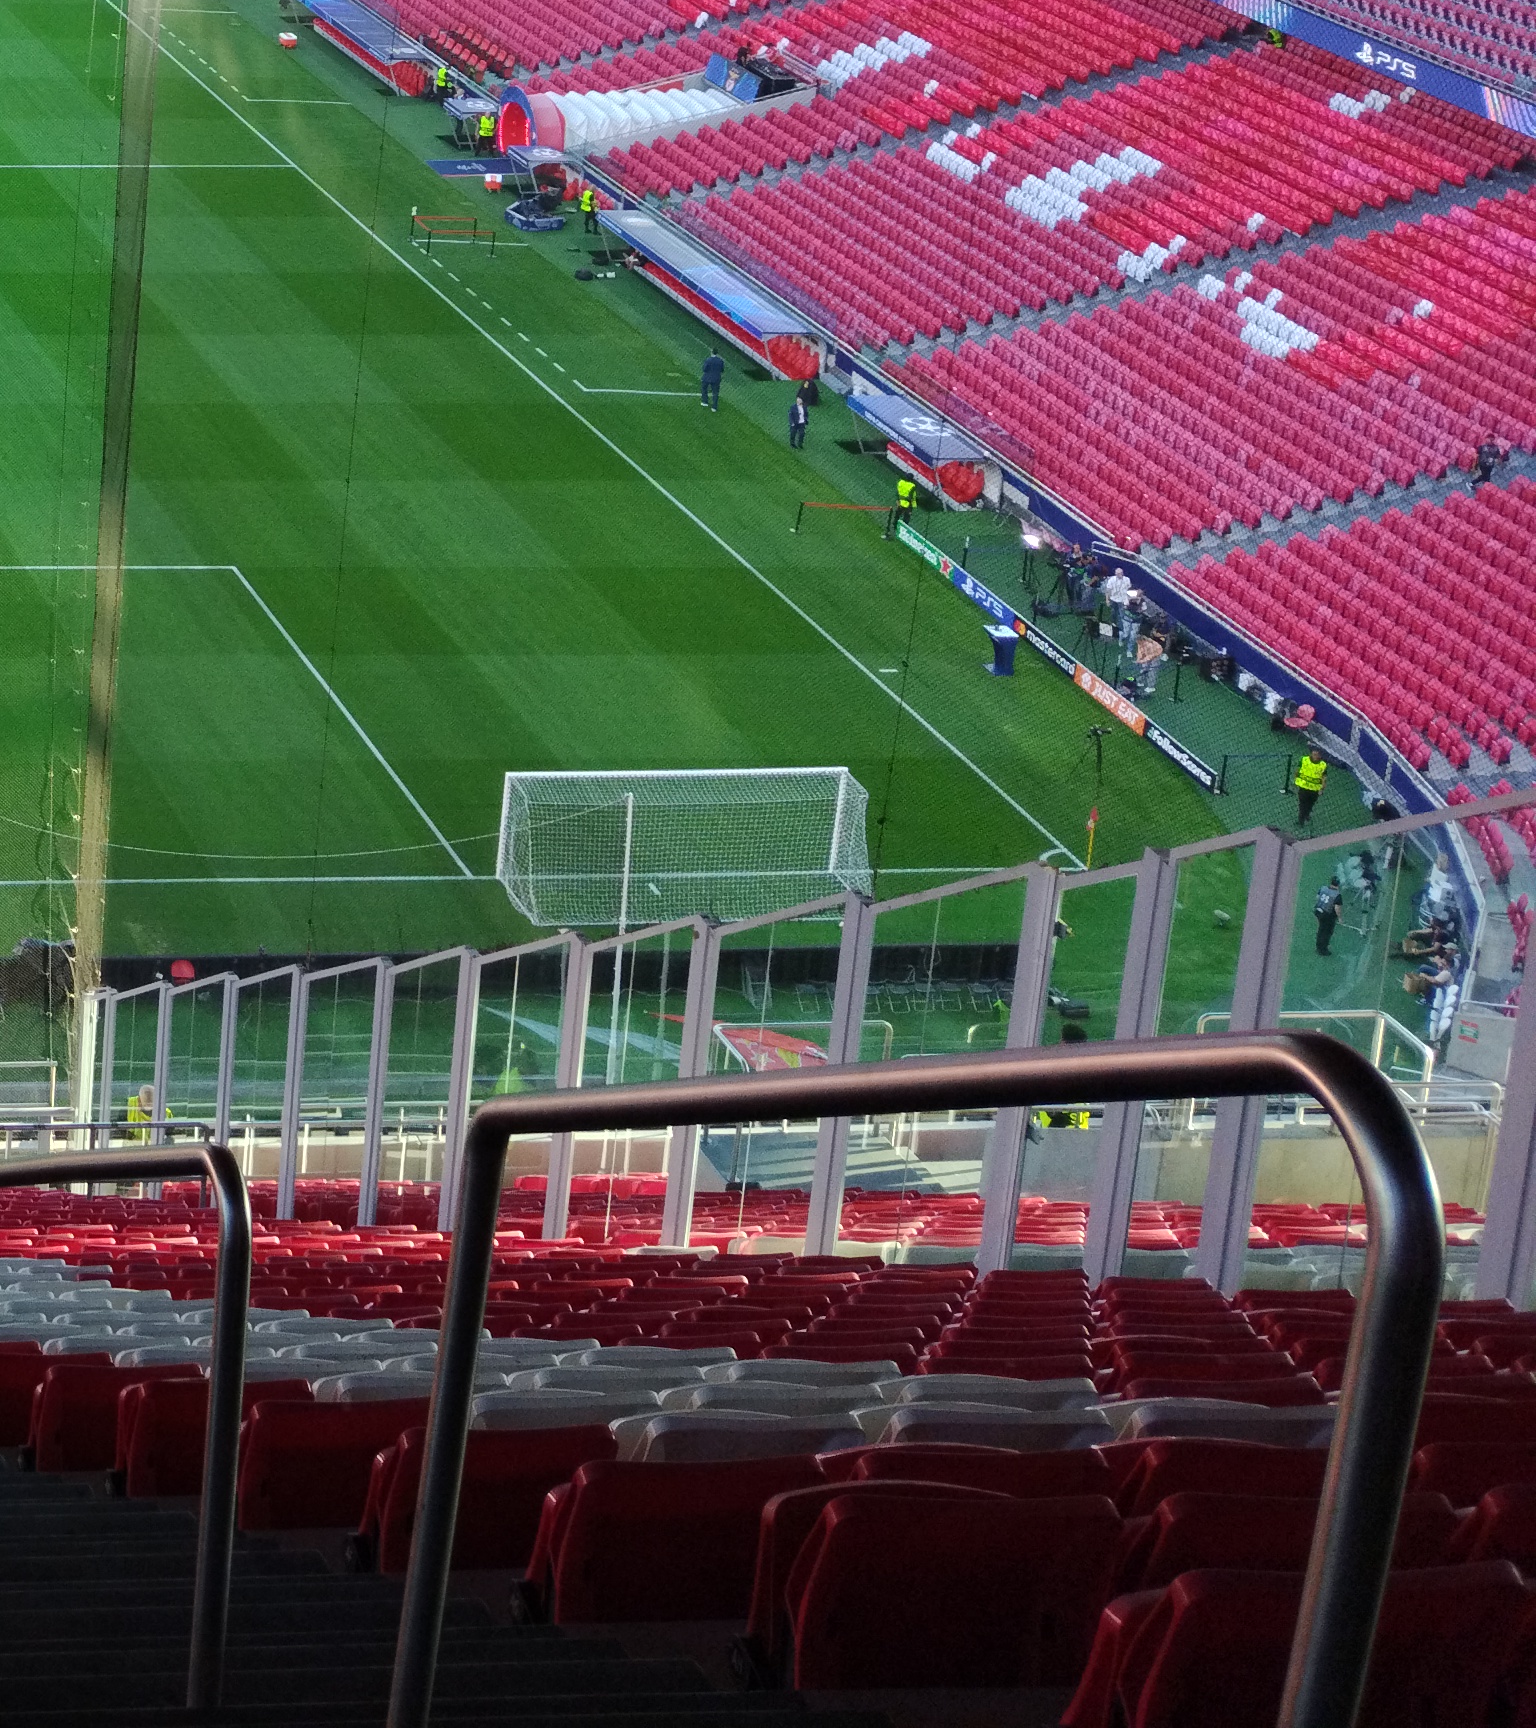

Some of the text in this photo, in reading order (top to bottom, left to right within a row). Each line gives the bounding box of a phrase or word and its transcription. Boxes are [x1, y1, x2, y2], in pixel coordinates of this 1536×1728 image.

[1375, 50, 1417, 81] PS5
[975, 588, 1004, 620] PS5
[1026, 629, 1077, 676] mastercard
[1091, 680, 1140, 727] JUST EAT
